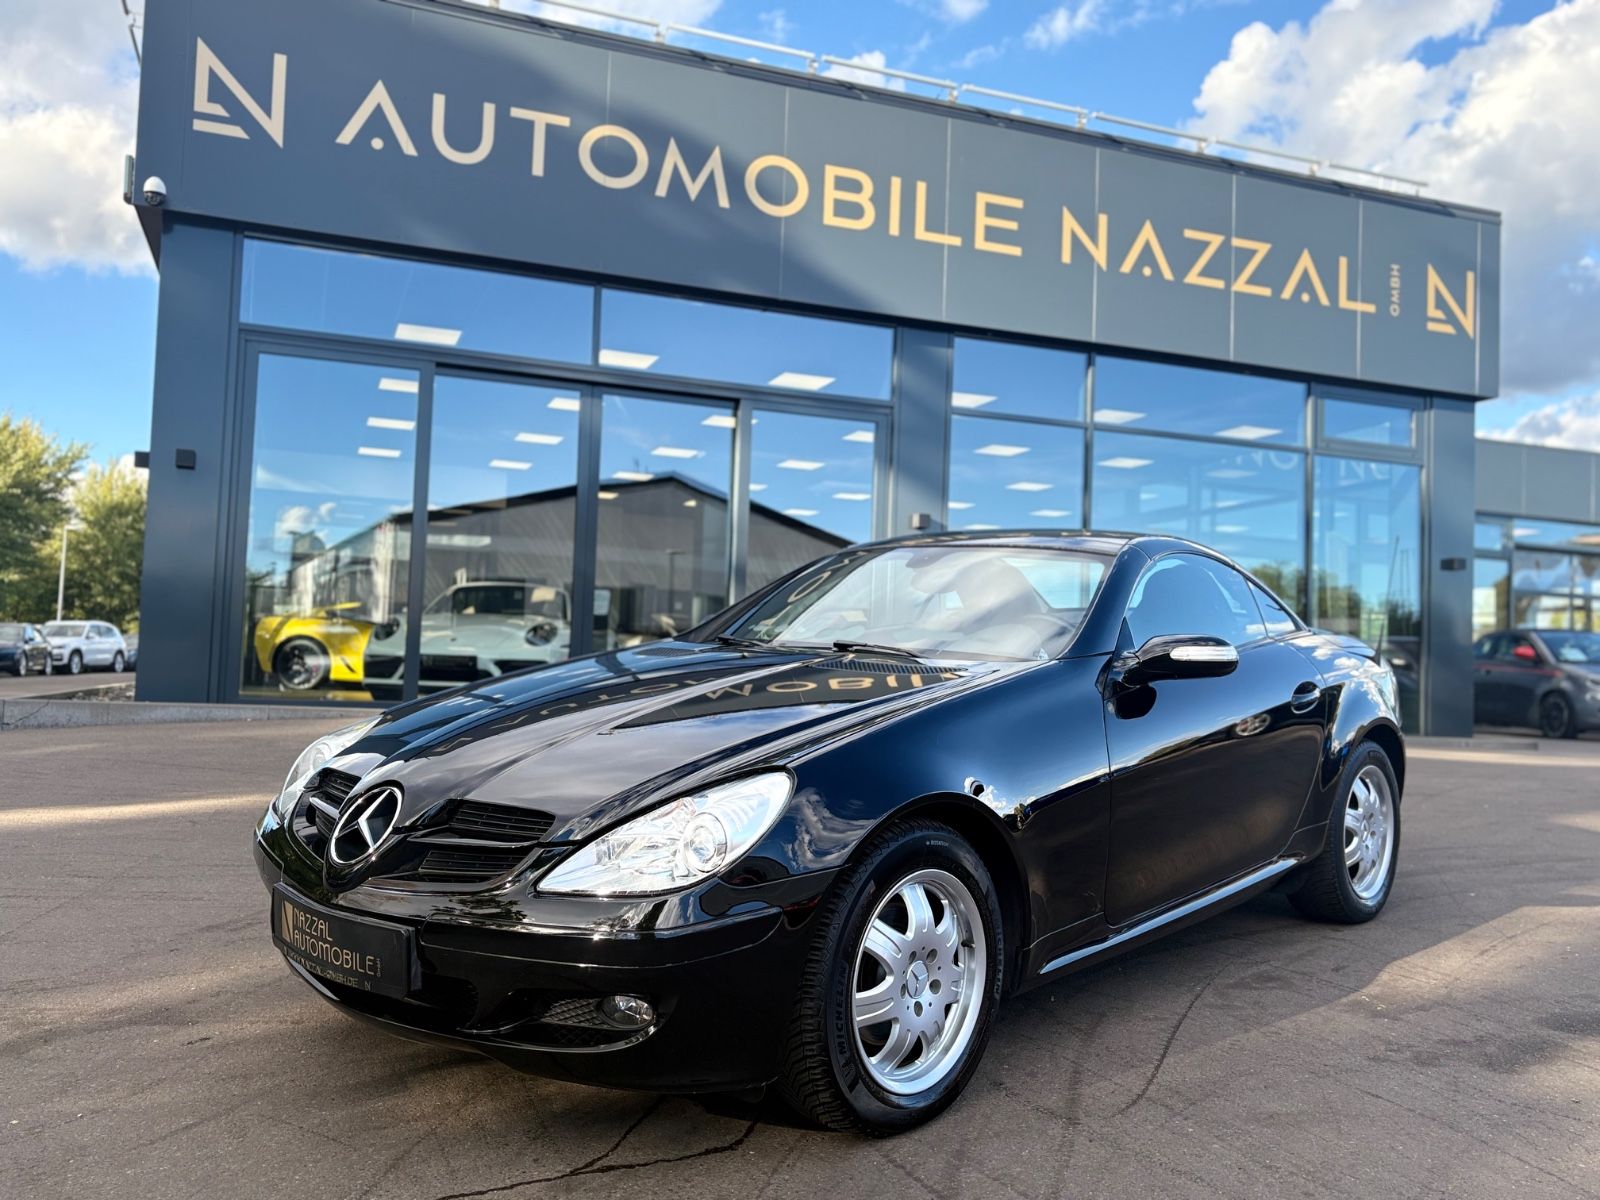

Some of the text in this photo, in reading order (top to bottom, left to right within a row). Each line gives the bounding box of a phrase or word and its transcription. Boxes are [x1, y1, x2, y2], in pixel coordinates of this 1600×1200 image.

[335, 79, 1377, 314] AUTOMOBILE NAZZAL
[294, 907, 333, 942] NAZZAL
[294, 929, 375, 976] AUTOMOBILE
[835, 966, 849, 1056] MICHELIN
